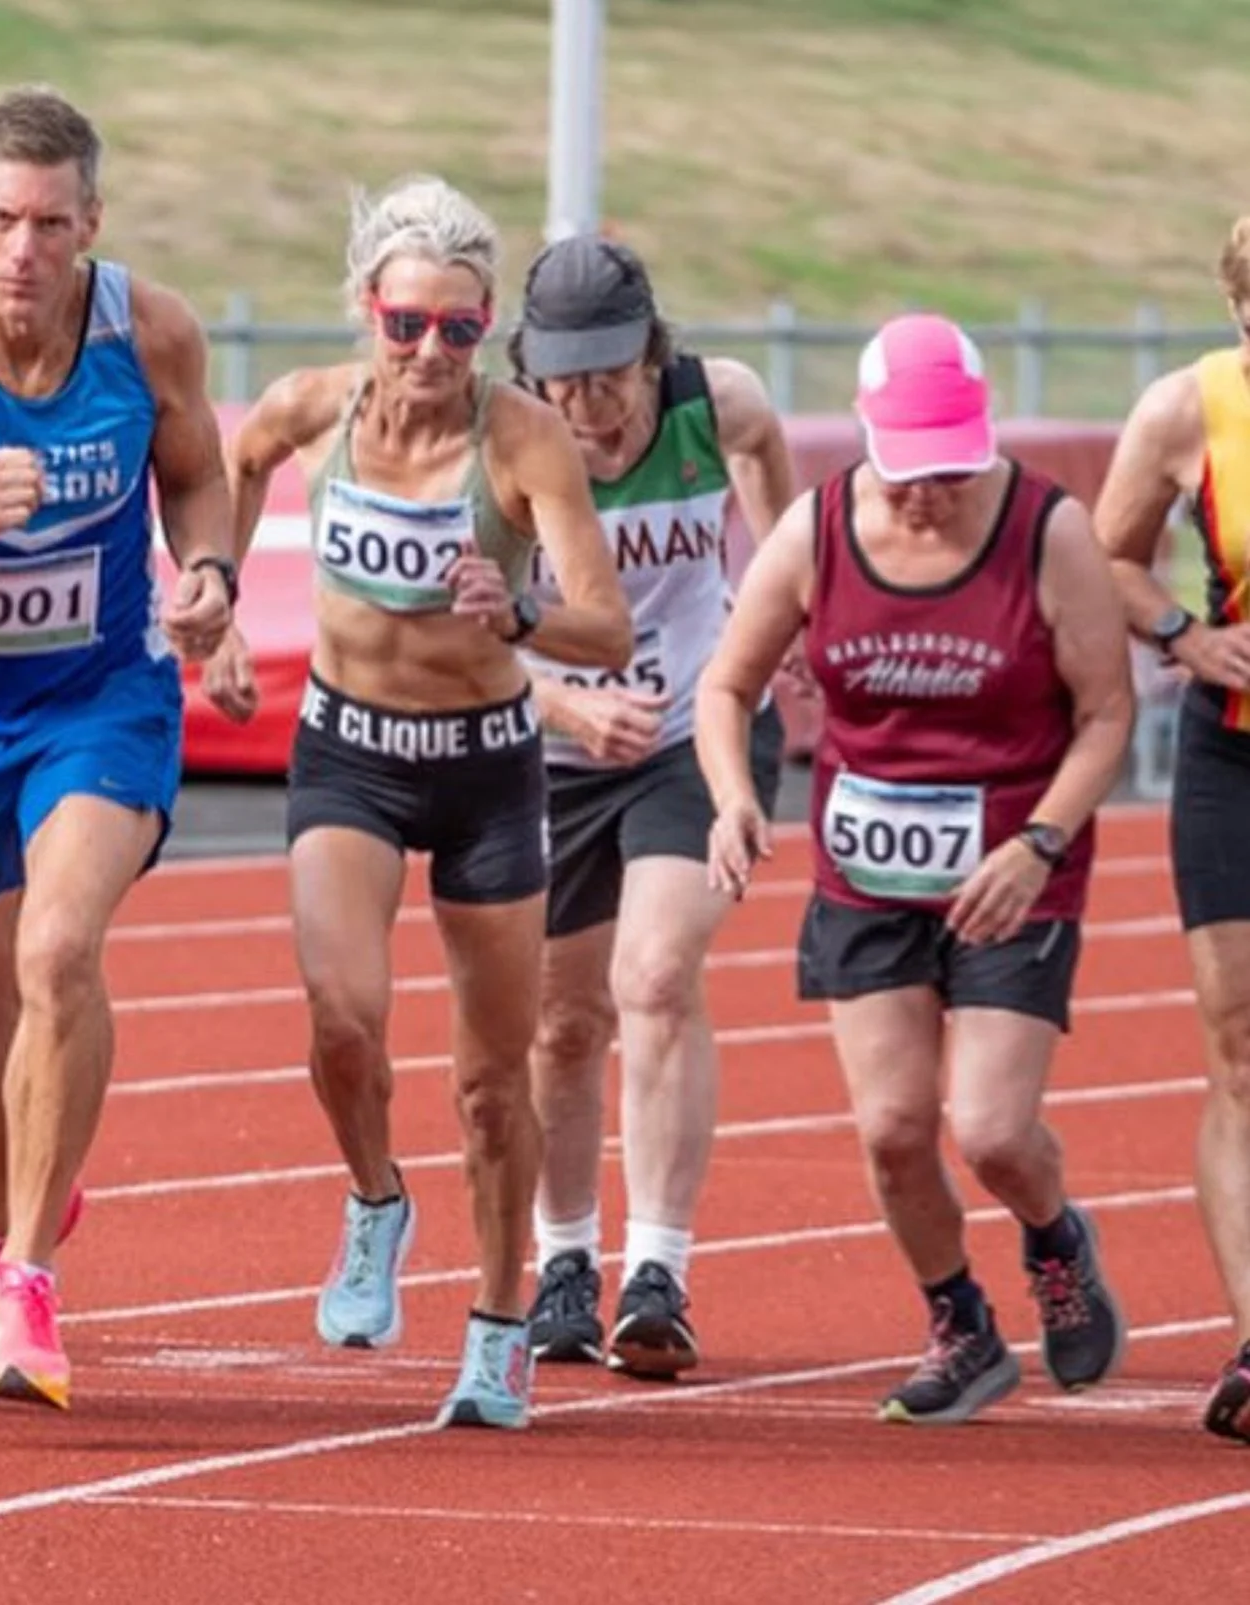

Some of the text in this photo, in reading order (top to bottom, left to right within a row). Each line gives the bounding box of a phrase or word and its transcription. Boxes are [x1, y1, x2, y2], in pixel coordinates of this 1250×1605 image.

[324, 521, 463, 583] 5002
[825, 632, 1007, 672] MARLBOROUGH
[337, 701, 470, 764] CLIQUE
[830, 811, 972, 870] 5007
